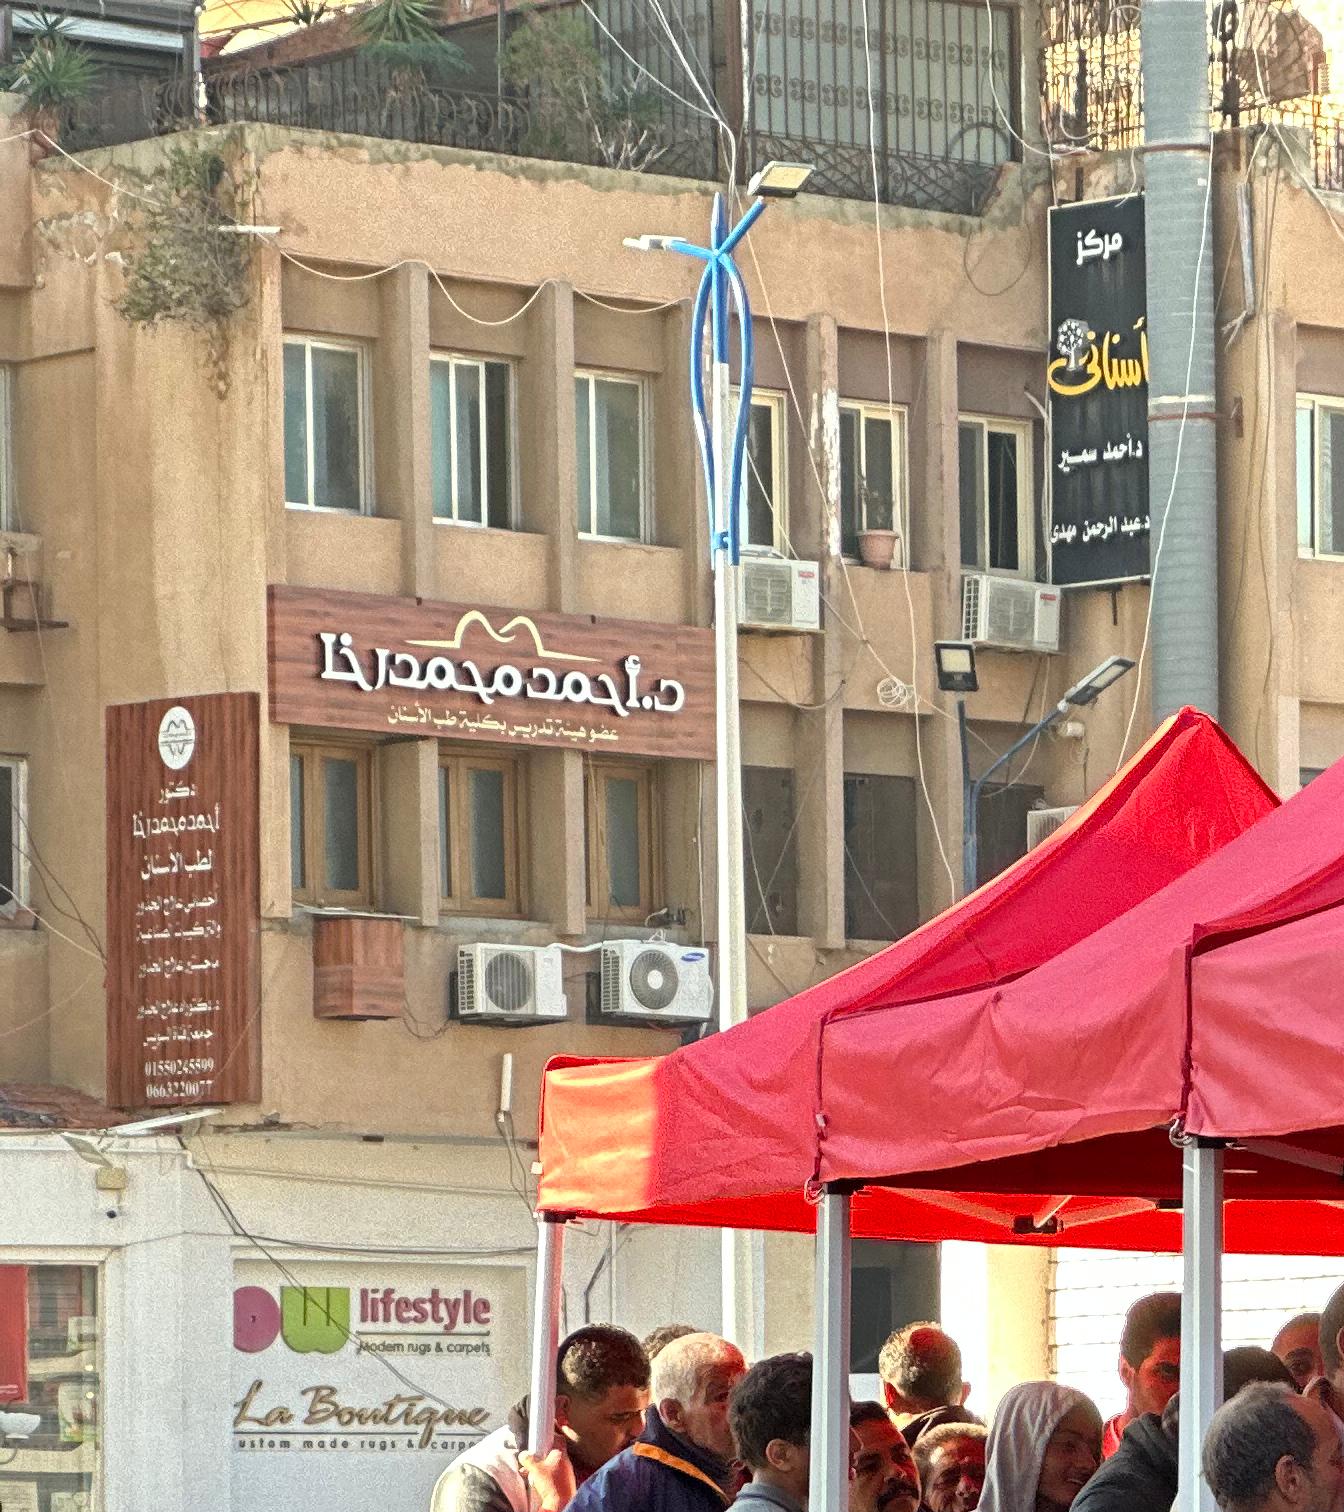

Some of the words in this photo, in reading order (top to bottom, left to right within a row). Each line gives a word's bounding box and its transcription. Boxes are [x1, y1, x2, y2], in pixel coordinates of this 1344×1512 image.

[1076, 229, 1123, 265] مركز
[1082, 516, 1117, 542] الرحمن
[390, 654, 523, 705] محمد
[433, 710, 457, 730] طب
[459, 710, 507, 733] بكلية
[508, 718, 554, 739] تدريس
[589, 724, 619, 743] عضو
[359, 1287, 491, 1331] lifestyle
[360, 1340, 404, 1353] Modern
[407, 1342, 432, 1356] rugs
[434, 1341, 444, 1353] &
[446, 1341, 491, 1356] carpets
[233, 1379, 296, 1427] La
[301, 1385, 491, 1449] Boutique
[303, 1438, 349, 1449] made
[360, 1439, 396, 1450] rugs
